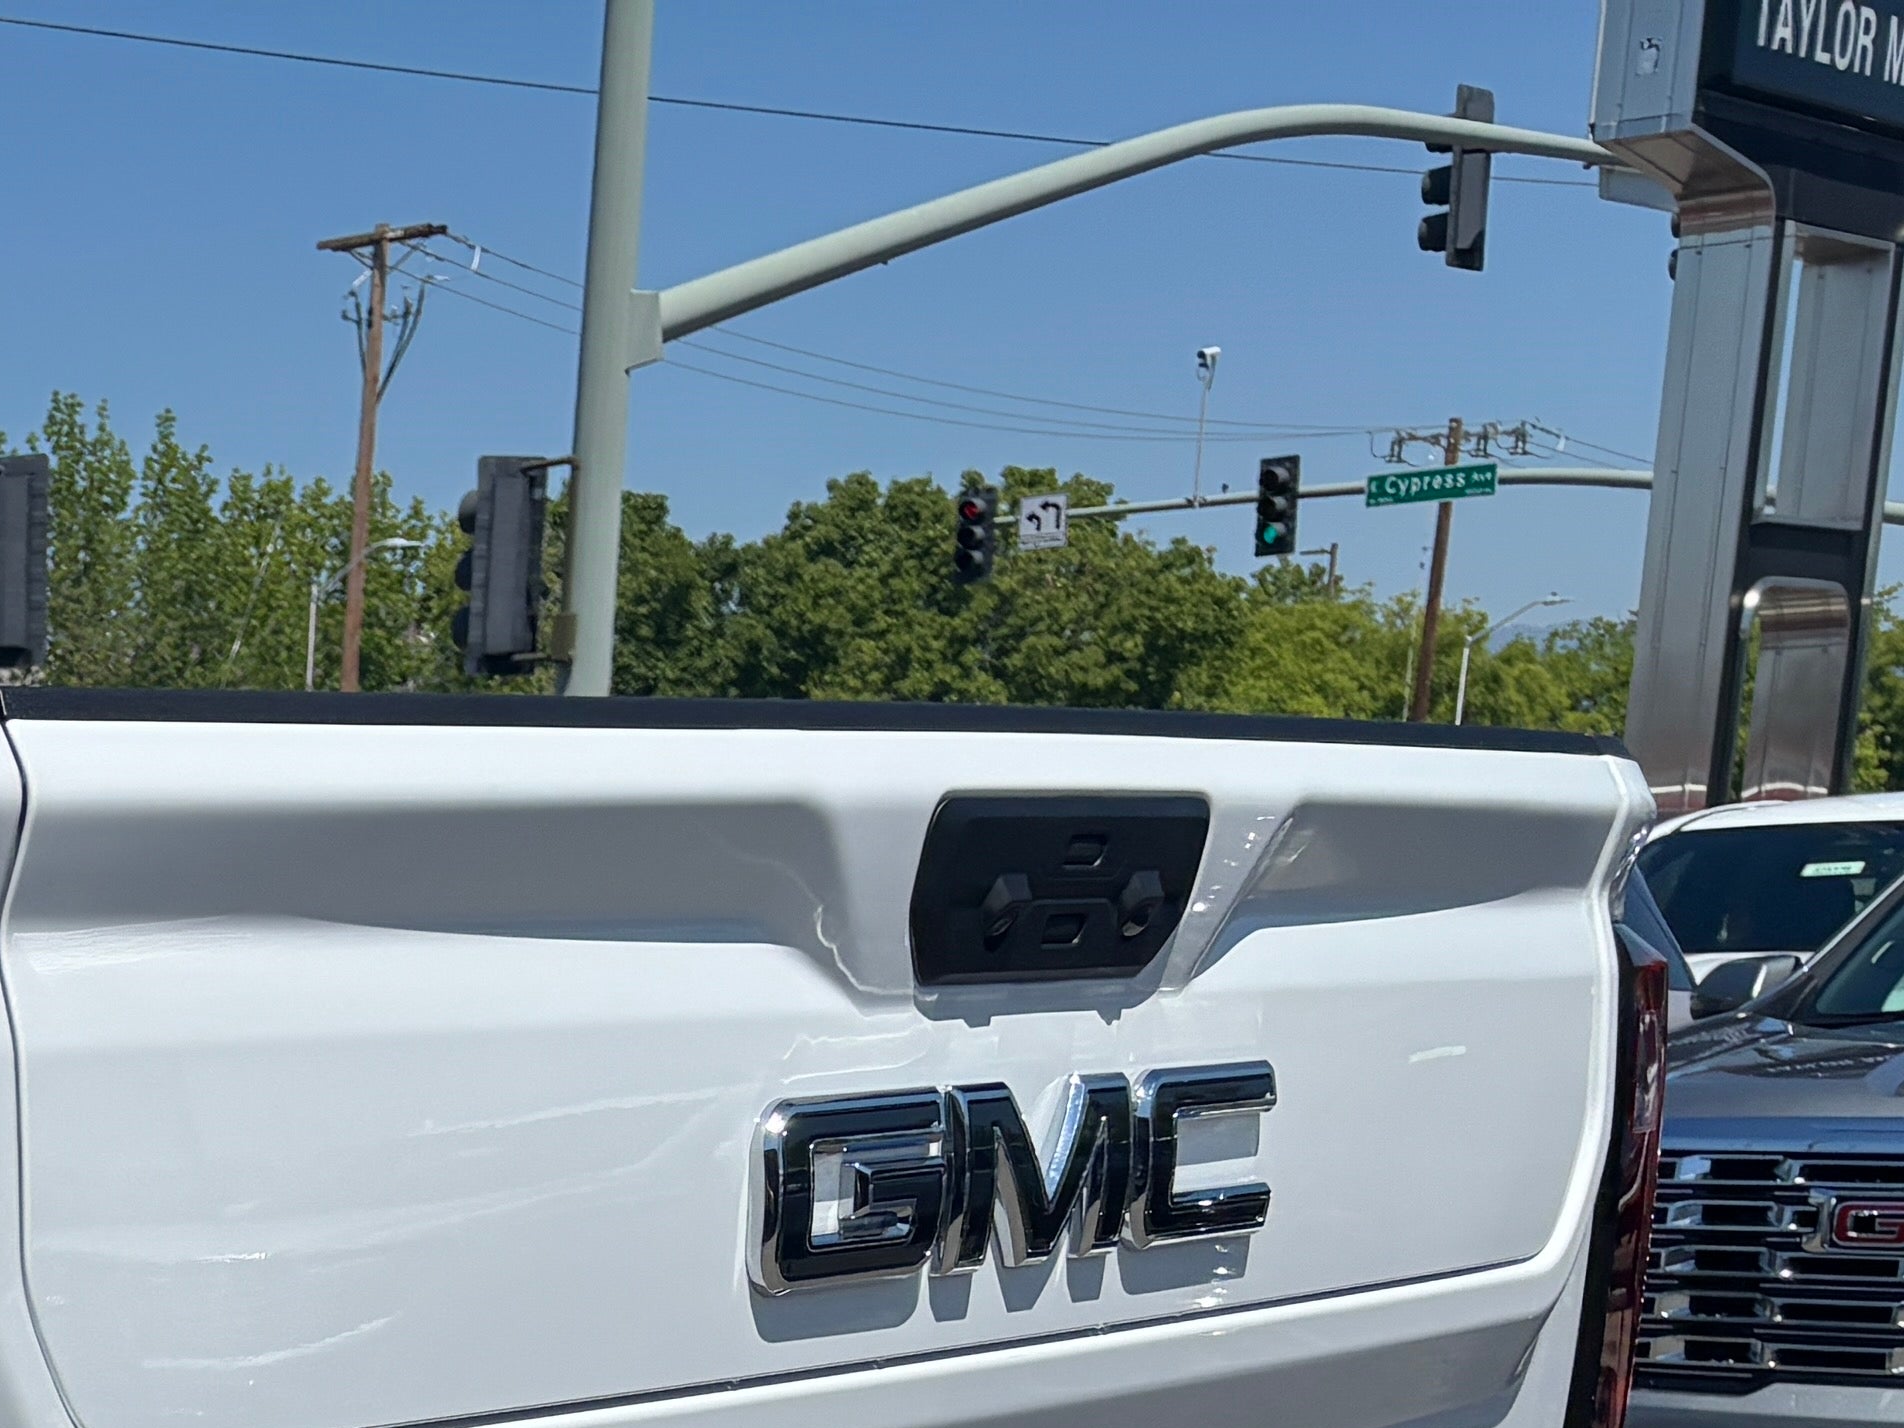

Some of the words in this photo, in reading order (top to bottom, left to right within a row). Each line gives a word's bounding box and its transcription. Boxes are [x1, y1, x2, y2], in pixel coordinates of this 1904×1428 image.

[1756, 0, 1877, 76] TAYLOR
[1385, 472, 1466, 497] Cypress
[747, 1059, 1278, 1297] GMC
